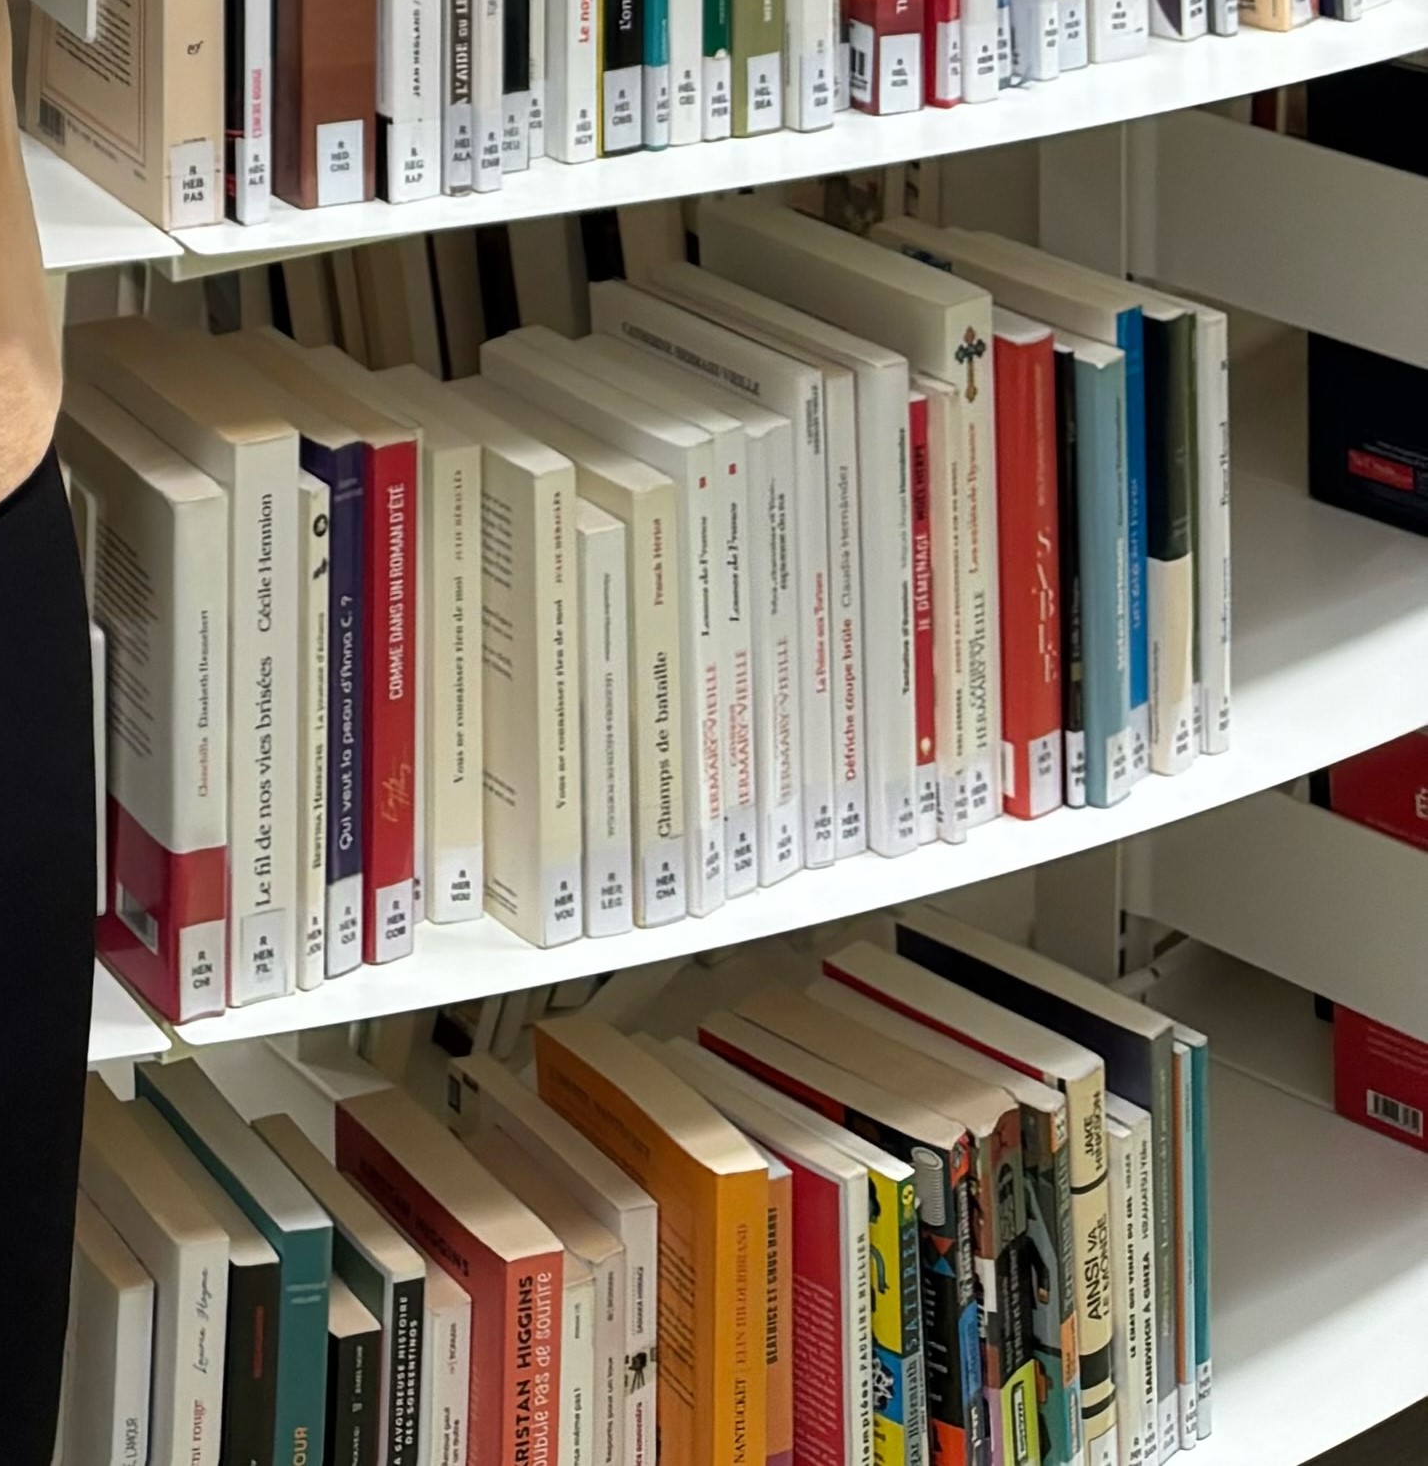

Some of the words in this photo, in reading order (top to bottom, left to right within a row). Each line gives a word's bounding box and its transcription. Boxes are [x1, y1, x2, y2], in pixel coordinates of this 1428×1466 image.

[578, 25, 590, 44] Le
[386, 483, 405, 520] D'ÉTÉ
[257, 492, 273, 571] Hennion
[388, 524, 405, 576] ROMAN
[255, 576, 273, 632] Cécile
[388, 578, 404, 600] UN
[388, 602, 405, 641] DANS
[254, 656, 273, 728] brisées
[388, 644, 405, 699] COMME
[653, 651, 669, 723] bataille
[257, 734, 273, 775] vies
[655, 728, 670, 753] de
[258, 779, 273, 818] nos
[655, 758, 674, 839] Champs
[254, 822, 272, 850] de
[253, 853, 272, 876] fil
[254, 881, 272, 908] Le
[1084, 1255, 1103, 1321] AINSI
[516, 1275, 534, 1369] HIGGINS
